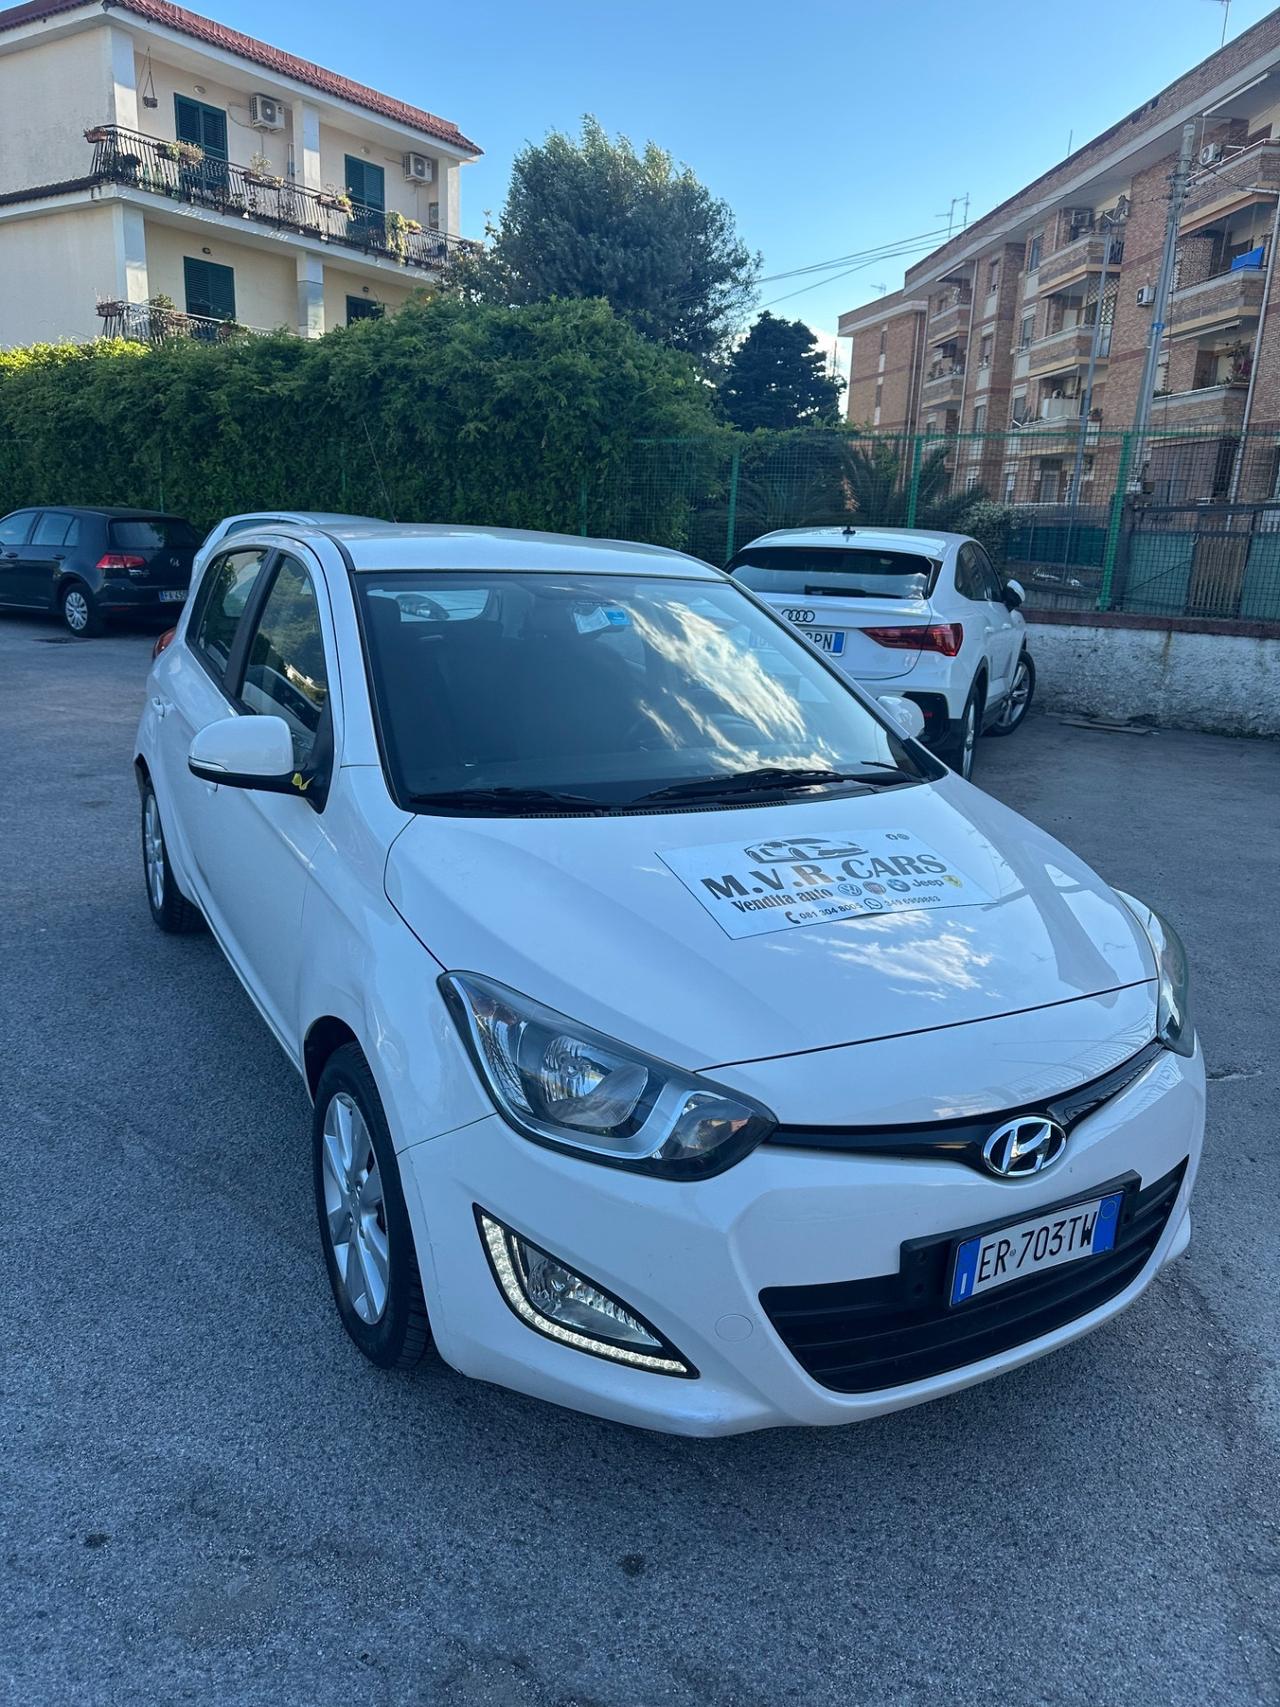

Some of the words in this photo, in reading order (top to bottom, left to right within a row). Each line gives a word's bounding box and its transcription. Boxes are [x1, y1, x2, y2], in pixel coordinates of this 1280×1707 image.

[912, 878, 945, 888] Jeep
[730, 893, 797, 913] Vendita
[796, 888, 834, 903] auto
